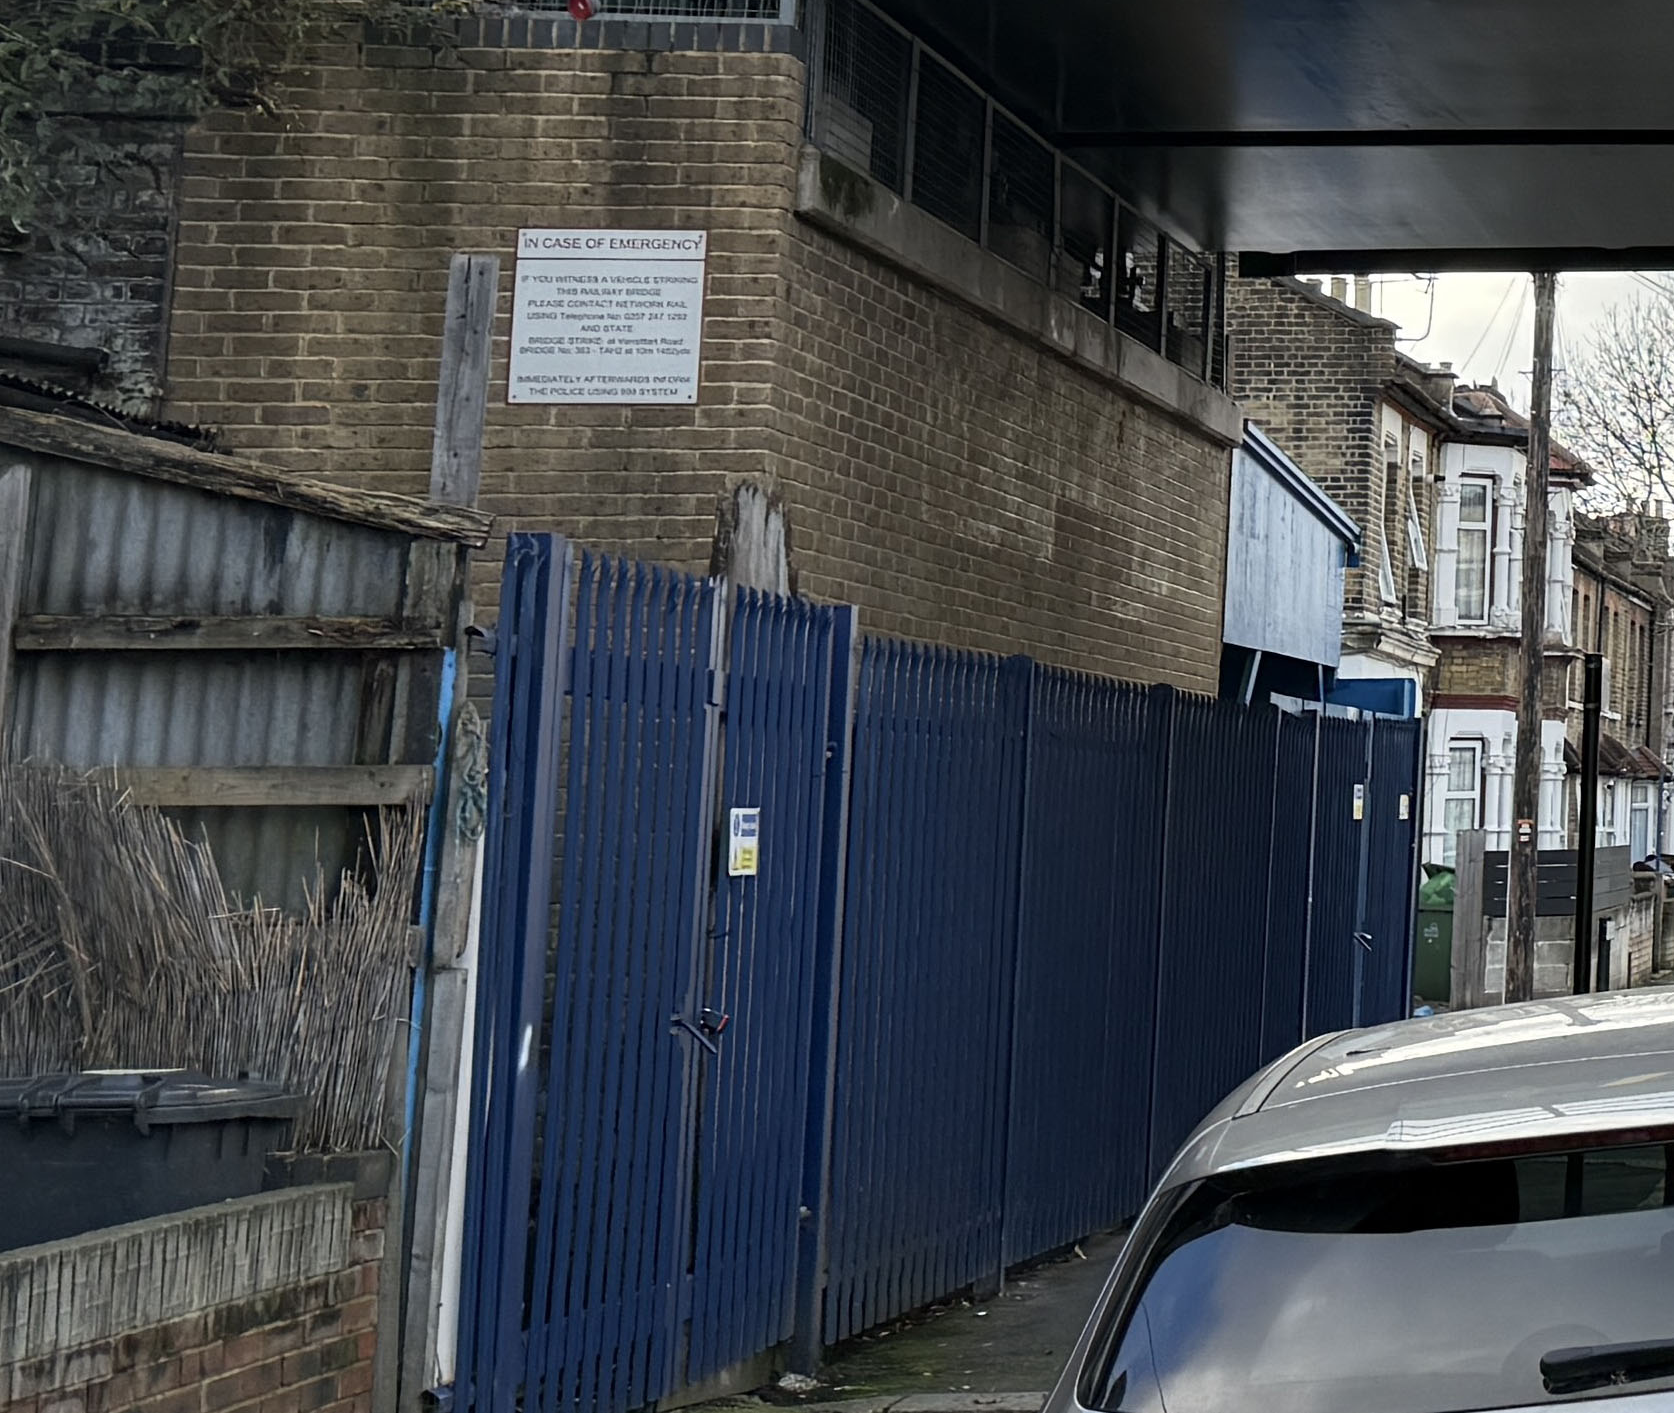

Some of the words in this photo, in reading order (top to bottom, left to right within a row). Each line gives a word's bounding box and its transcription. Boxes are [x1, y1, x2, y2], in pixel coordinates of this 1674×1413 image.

[523, 237, 539, 249] IN
[542, 237, 582, 249] CASE
[585, 238, 605, 249] OF
[609, 238, 700, 250] EMERGENCY
